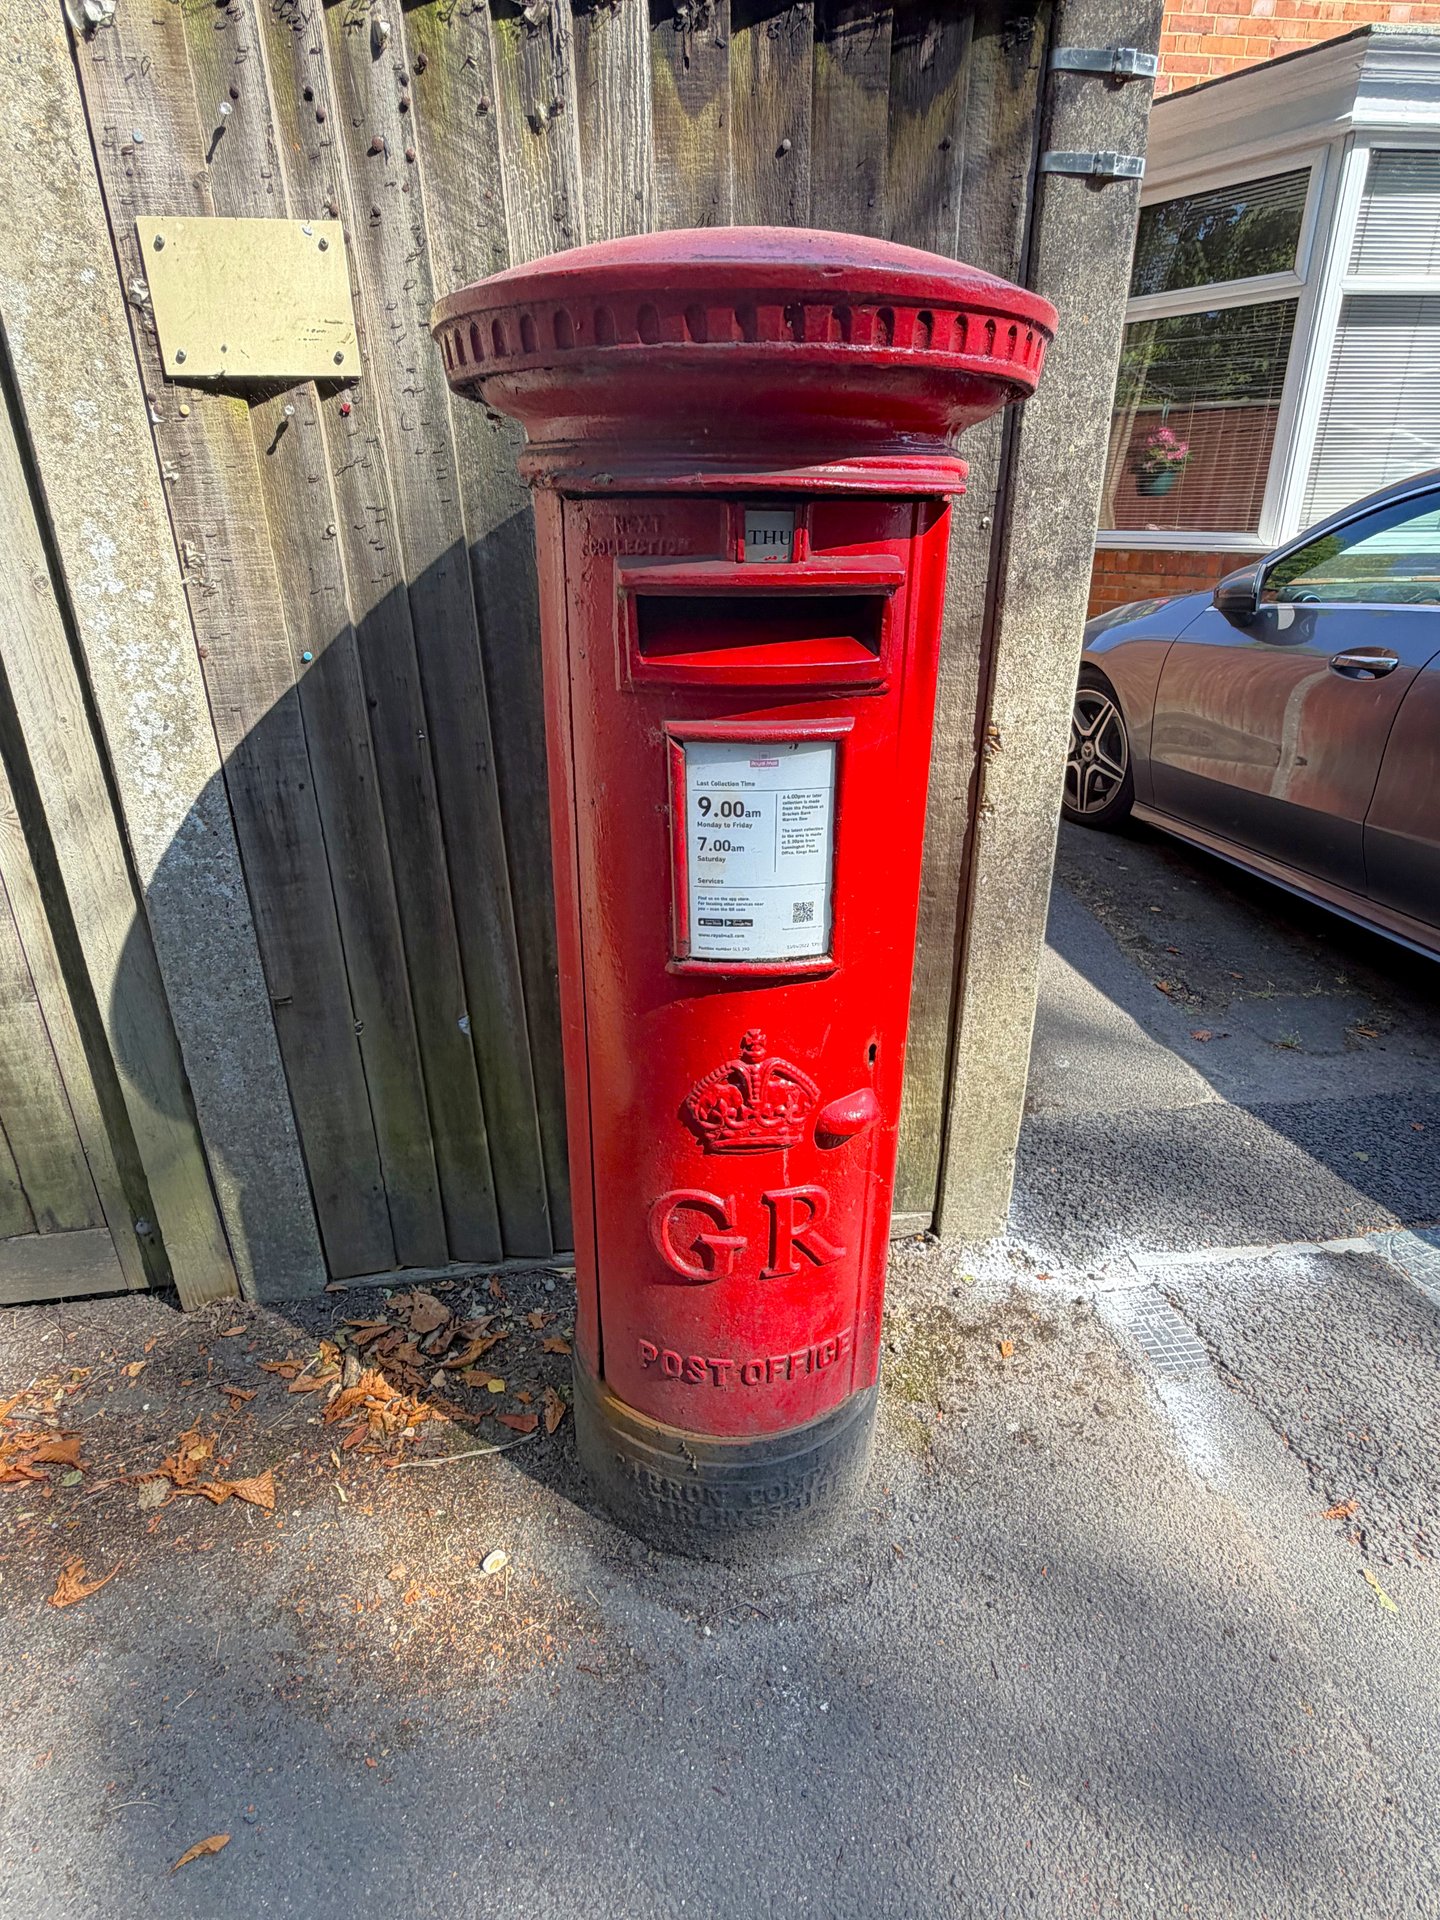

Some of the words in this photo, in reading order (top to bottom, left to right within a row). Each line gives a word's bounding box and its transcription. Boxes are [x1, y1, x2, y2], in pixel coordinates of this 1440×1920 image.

[748, 529, 792, 546] THU
[697, 796, 762, 818] 9.00am
[697, 821, 722, 829] Monday
[732, 821, 753, 829] Friday
[697, 836, 745, 853] 7.00am
[697, 855, 727, 864] Saturday
[697, 877, 724, 885] Services
[638, 1339, 733, 1387] POST
[740, 1328, 854, 1387] OFFICE
